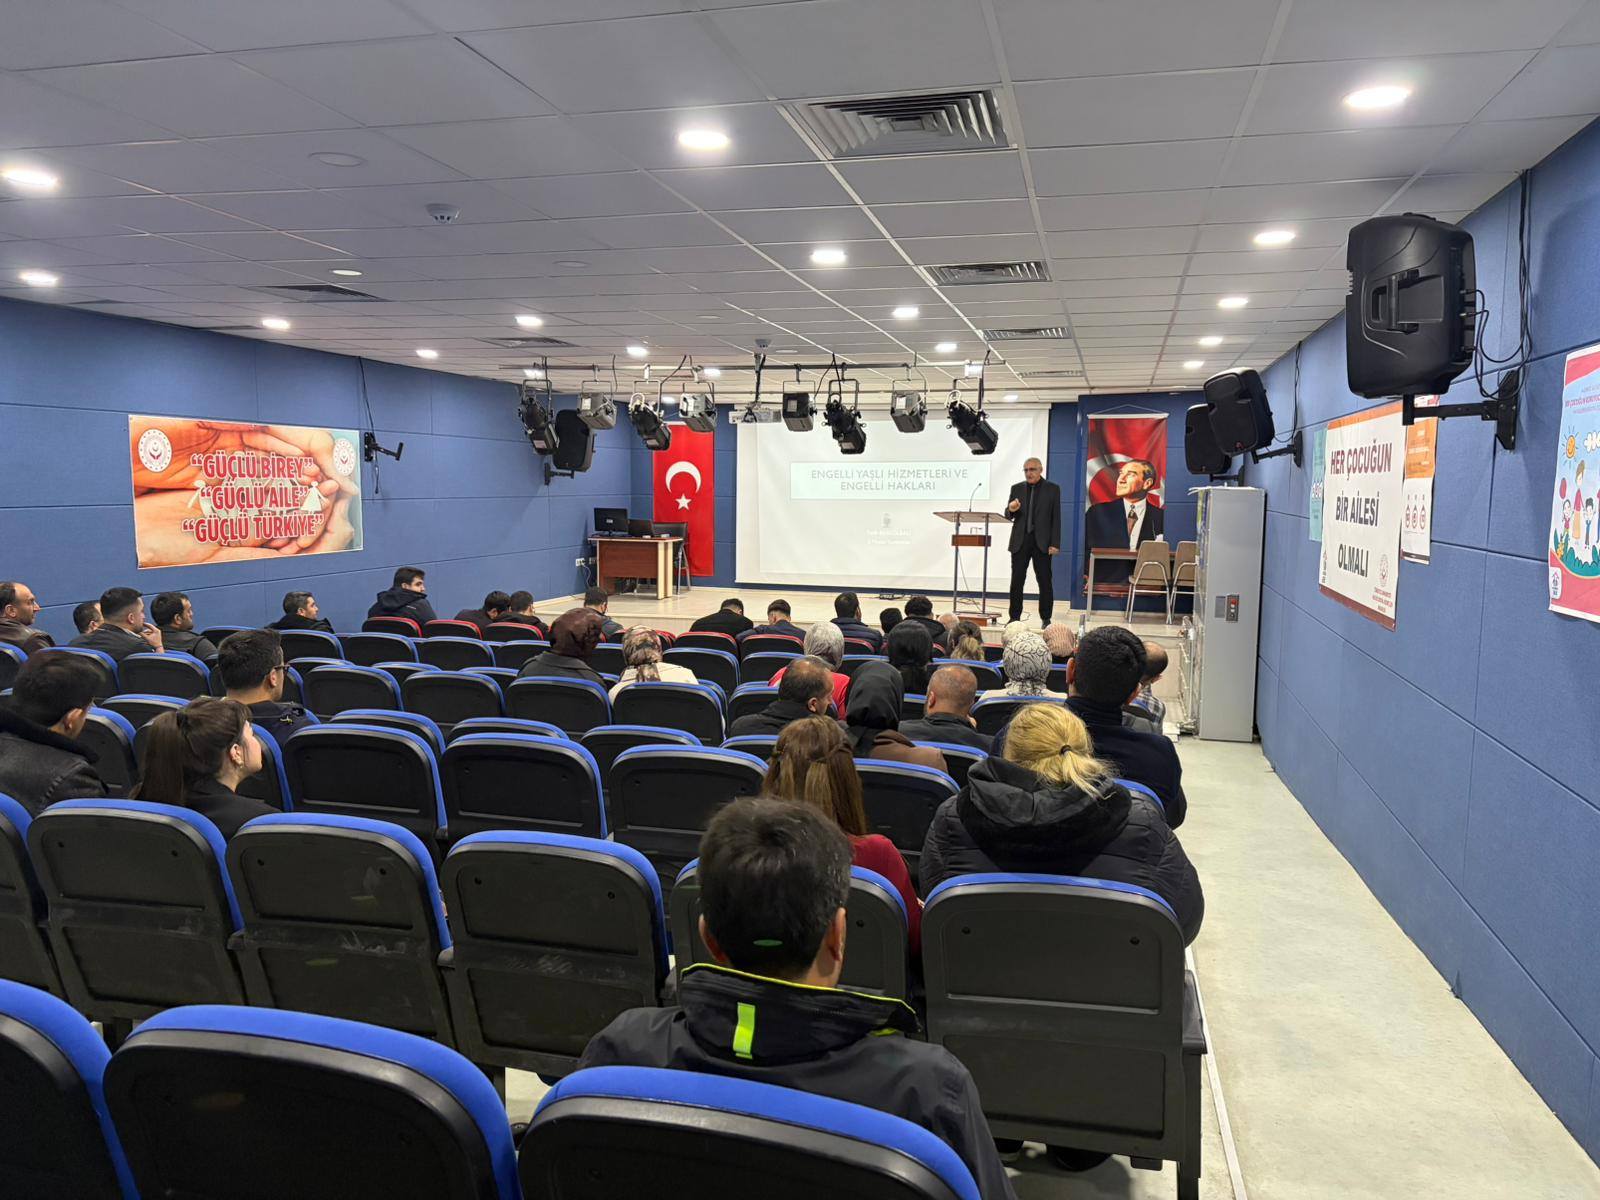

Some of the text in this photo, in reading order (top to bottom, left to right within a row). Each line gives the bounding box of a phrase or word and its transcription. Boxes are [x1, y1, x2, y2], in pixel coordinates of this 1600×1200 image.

[191, 450, 313, 480] “GÜÇLÜ BİREY”
[811, 467, 968, 480] ENGELLİ YAŞLI HİZMETLERİ VE
[1330, 439, 1392, 480] HER ÇOCUĞUN
[201, 482, 265, 511] “GÜÇLÜ
[840, 480, 936, 491] ENGELLİ HAKLARI
[1335, 490, 1380, 528] BİR AİLESİ
[182, 512, 324, 545] “GÜÇLÜ TÜRKİYE”
[1337, 543, 1369, 578] OLMALI
